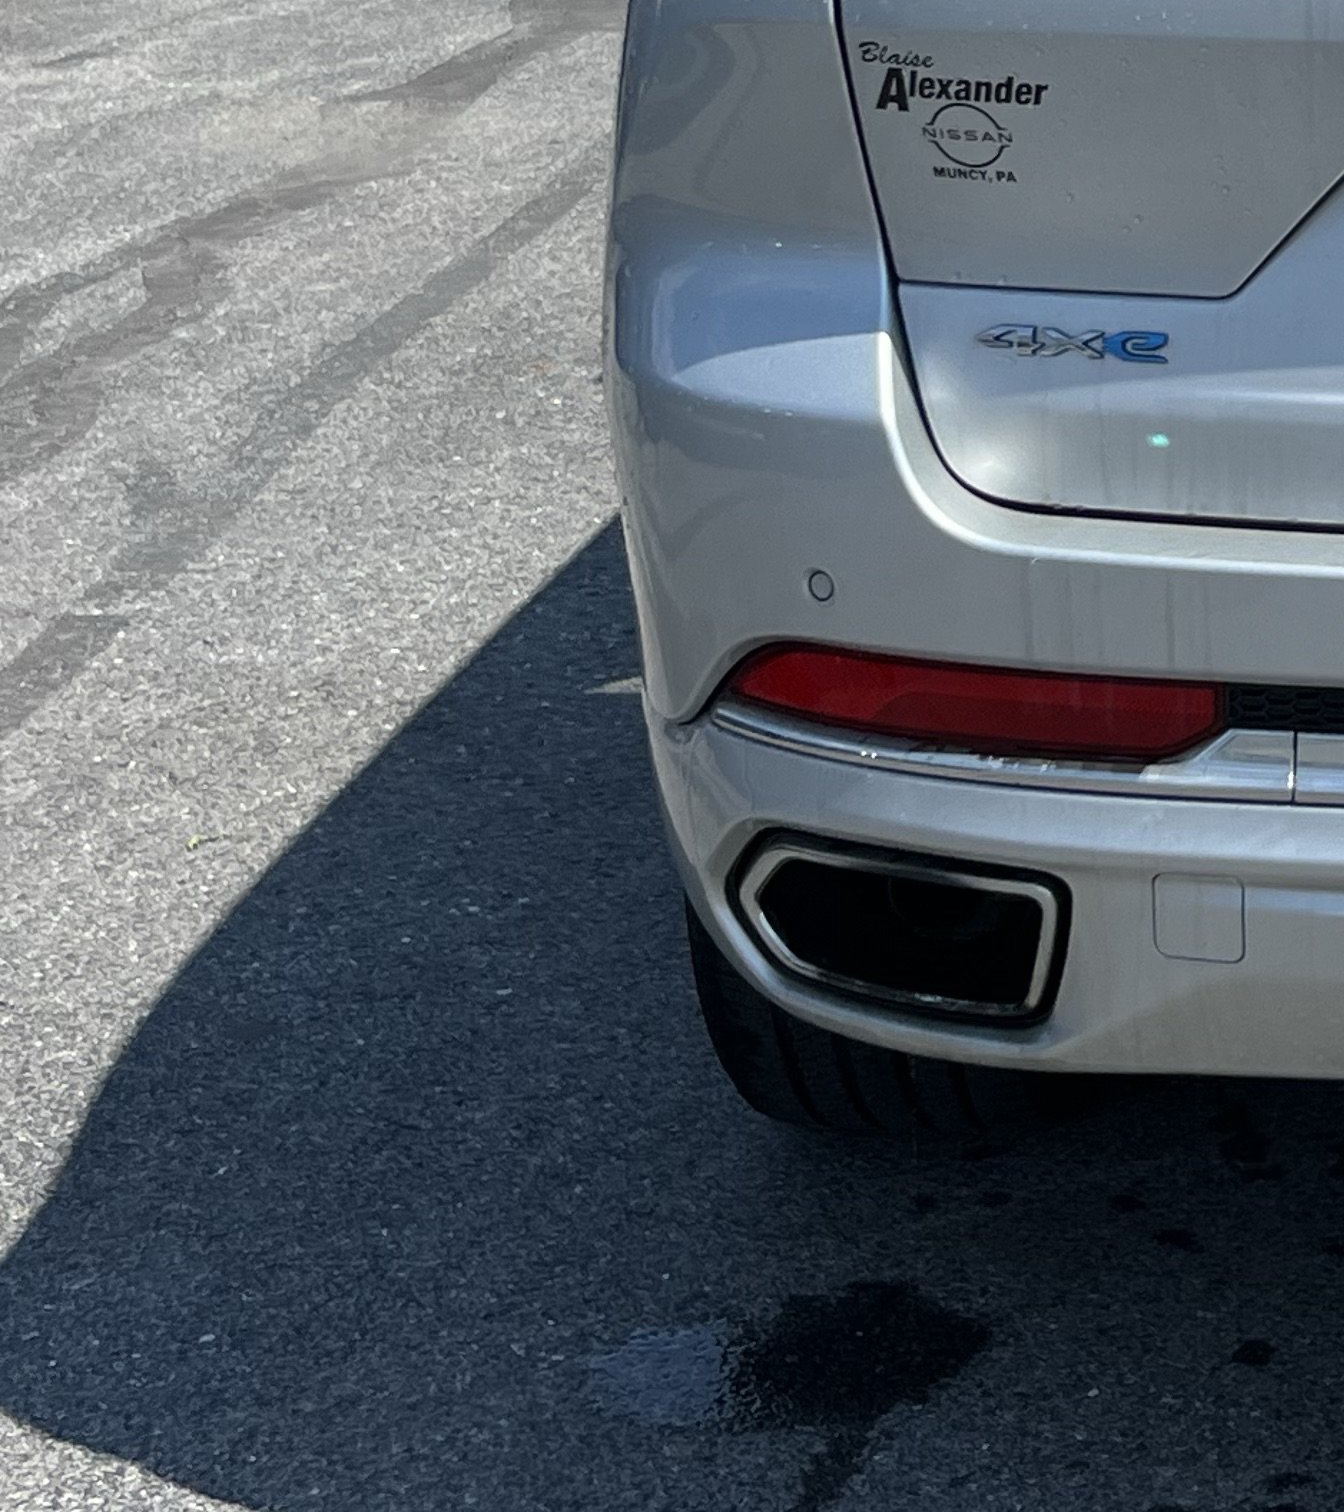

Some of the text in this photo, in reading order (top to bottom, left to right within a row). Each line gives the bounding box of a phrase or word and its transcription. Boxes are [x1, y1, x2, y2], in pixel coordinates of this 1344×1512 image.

[858, 41, 934, 68] Blaise
[876, 66, 1049, 112] Alexander
[921, 126, 1013, 143] NISSAN
[933, 166, 1017, 184] MUNCY, PA
